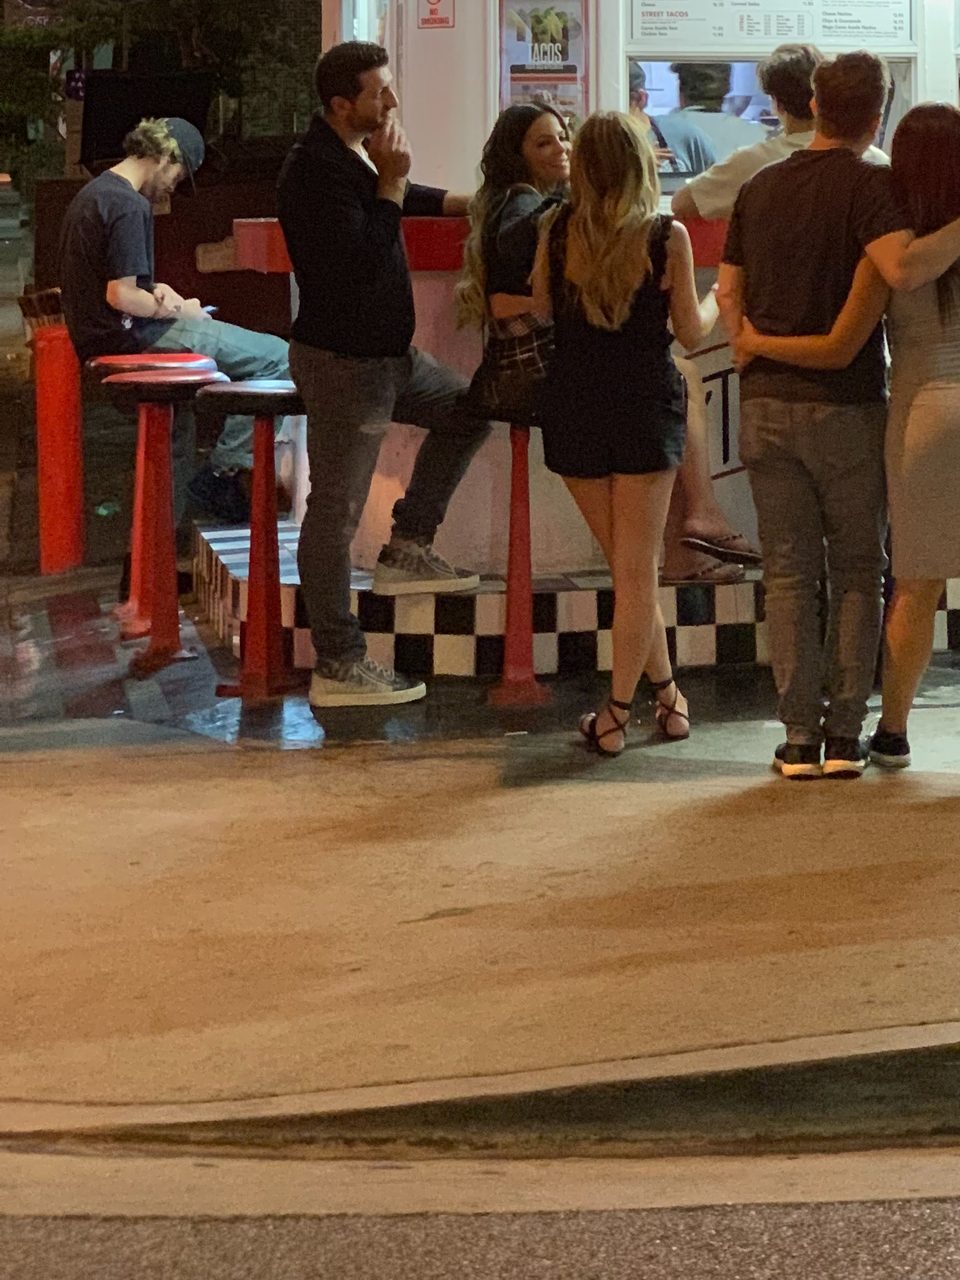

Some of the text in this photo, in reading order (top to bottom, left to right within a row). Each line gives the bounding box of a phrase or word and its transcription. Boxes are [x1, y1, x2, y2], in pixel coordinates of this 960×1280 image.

[429, 7, 439, 16] NO
[641, 10, 689, 18] STREET TACOS
[528, 42, 562, 64] TACOS
